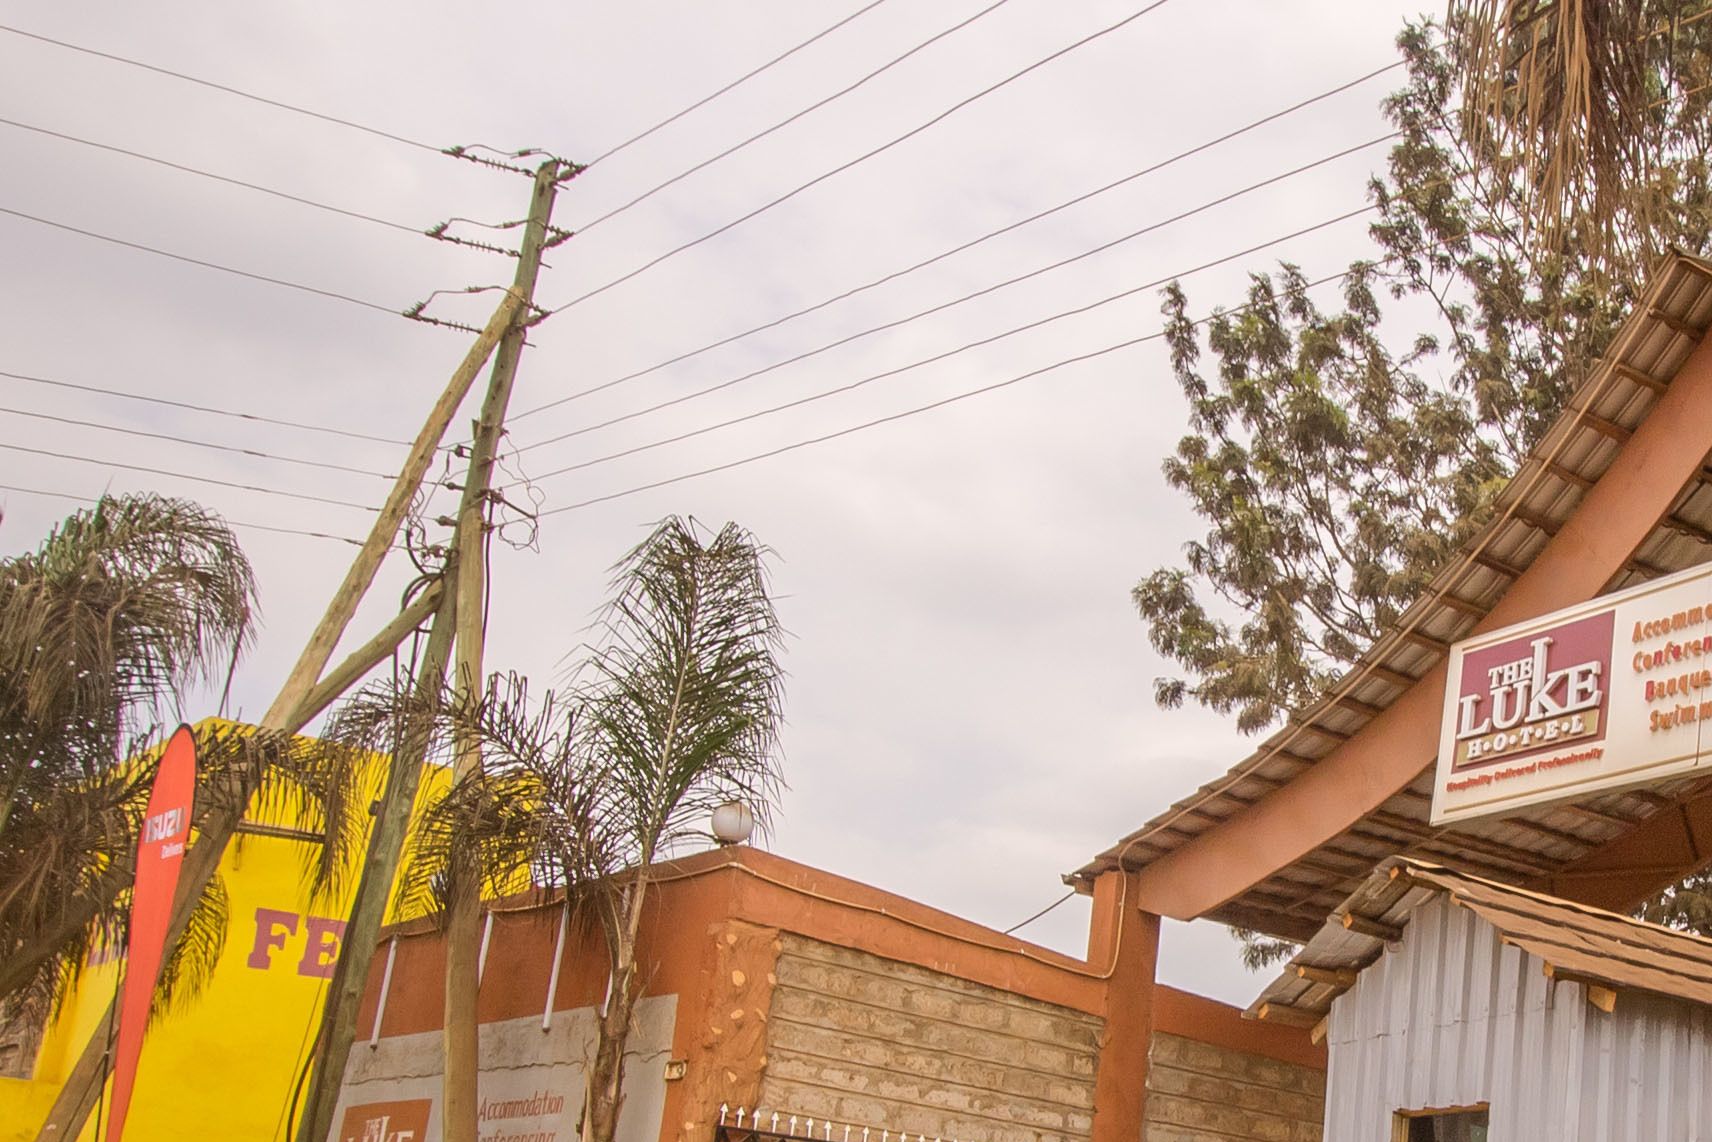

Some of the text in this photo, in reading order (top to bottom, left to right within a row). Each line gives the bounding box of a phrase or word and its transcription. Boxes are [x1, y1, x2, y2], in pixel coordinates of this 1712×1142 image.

[1456, 636, 1603, 740] LUKE
[1488, 657, 1534, 690] THE
[478, 1090, 565, 1122] Accommodation
